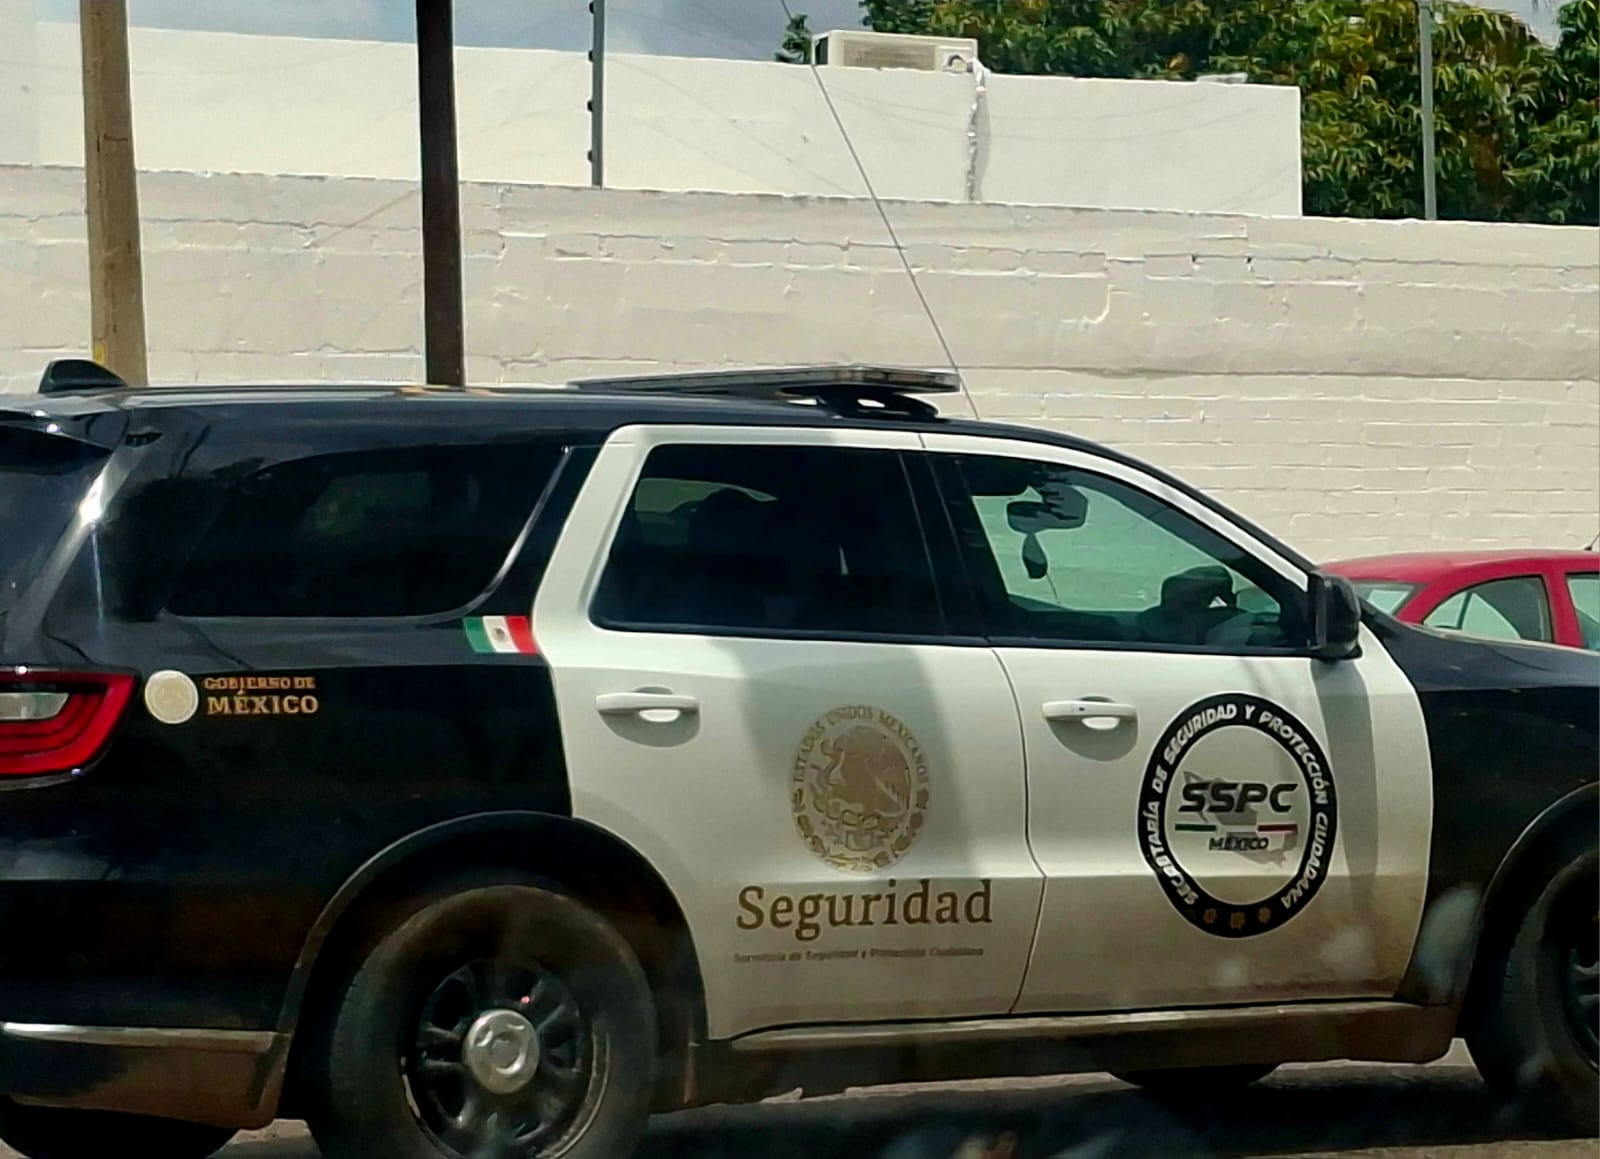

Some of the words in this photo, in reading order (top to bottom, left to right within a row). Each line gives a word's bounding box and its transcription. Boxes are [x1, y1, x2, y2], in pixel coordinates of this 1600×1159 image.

[204, 676, 290, 690] GOBIERNO
[294, 676, 316, 690] DE
[207, 689, 319, 715] MÉXICO
[1245, 704, 1255, 720] Y
[1164, 703, 1237, 765] SEGURIDAD
[1259, 710, 1330, 804] PROTECCIÓN
[1152, 765, 1167, 794] DE
[1178, 782, 1298, 813] SSPC
[1281, 812, 1328, 909] CIUDADANA
[736, 879, 993, 941] Seguridad
